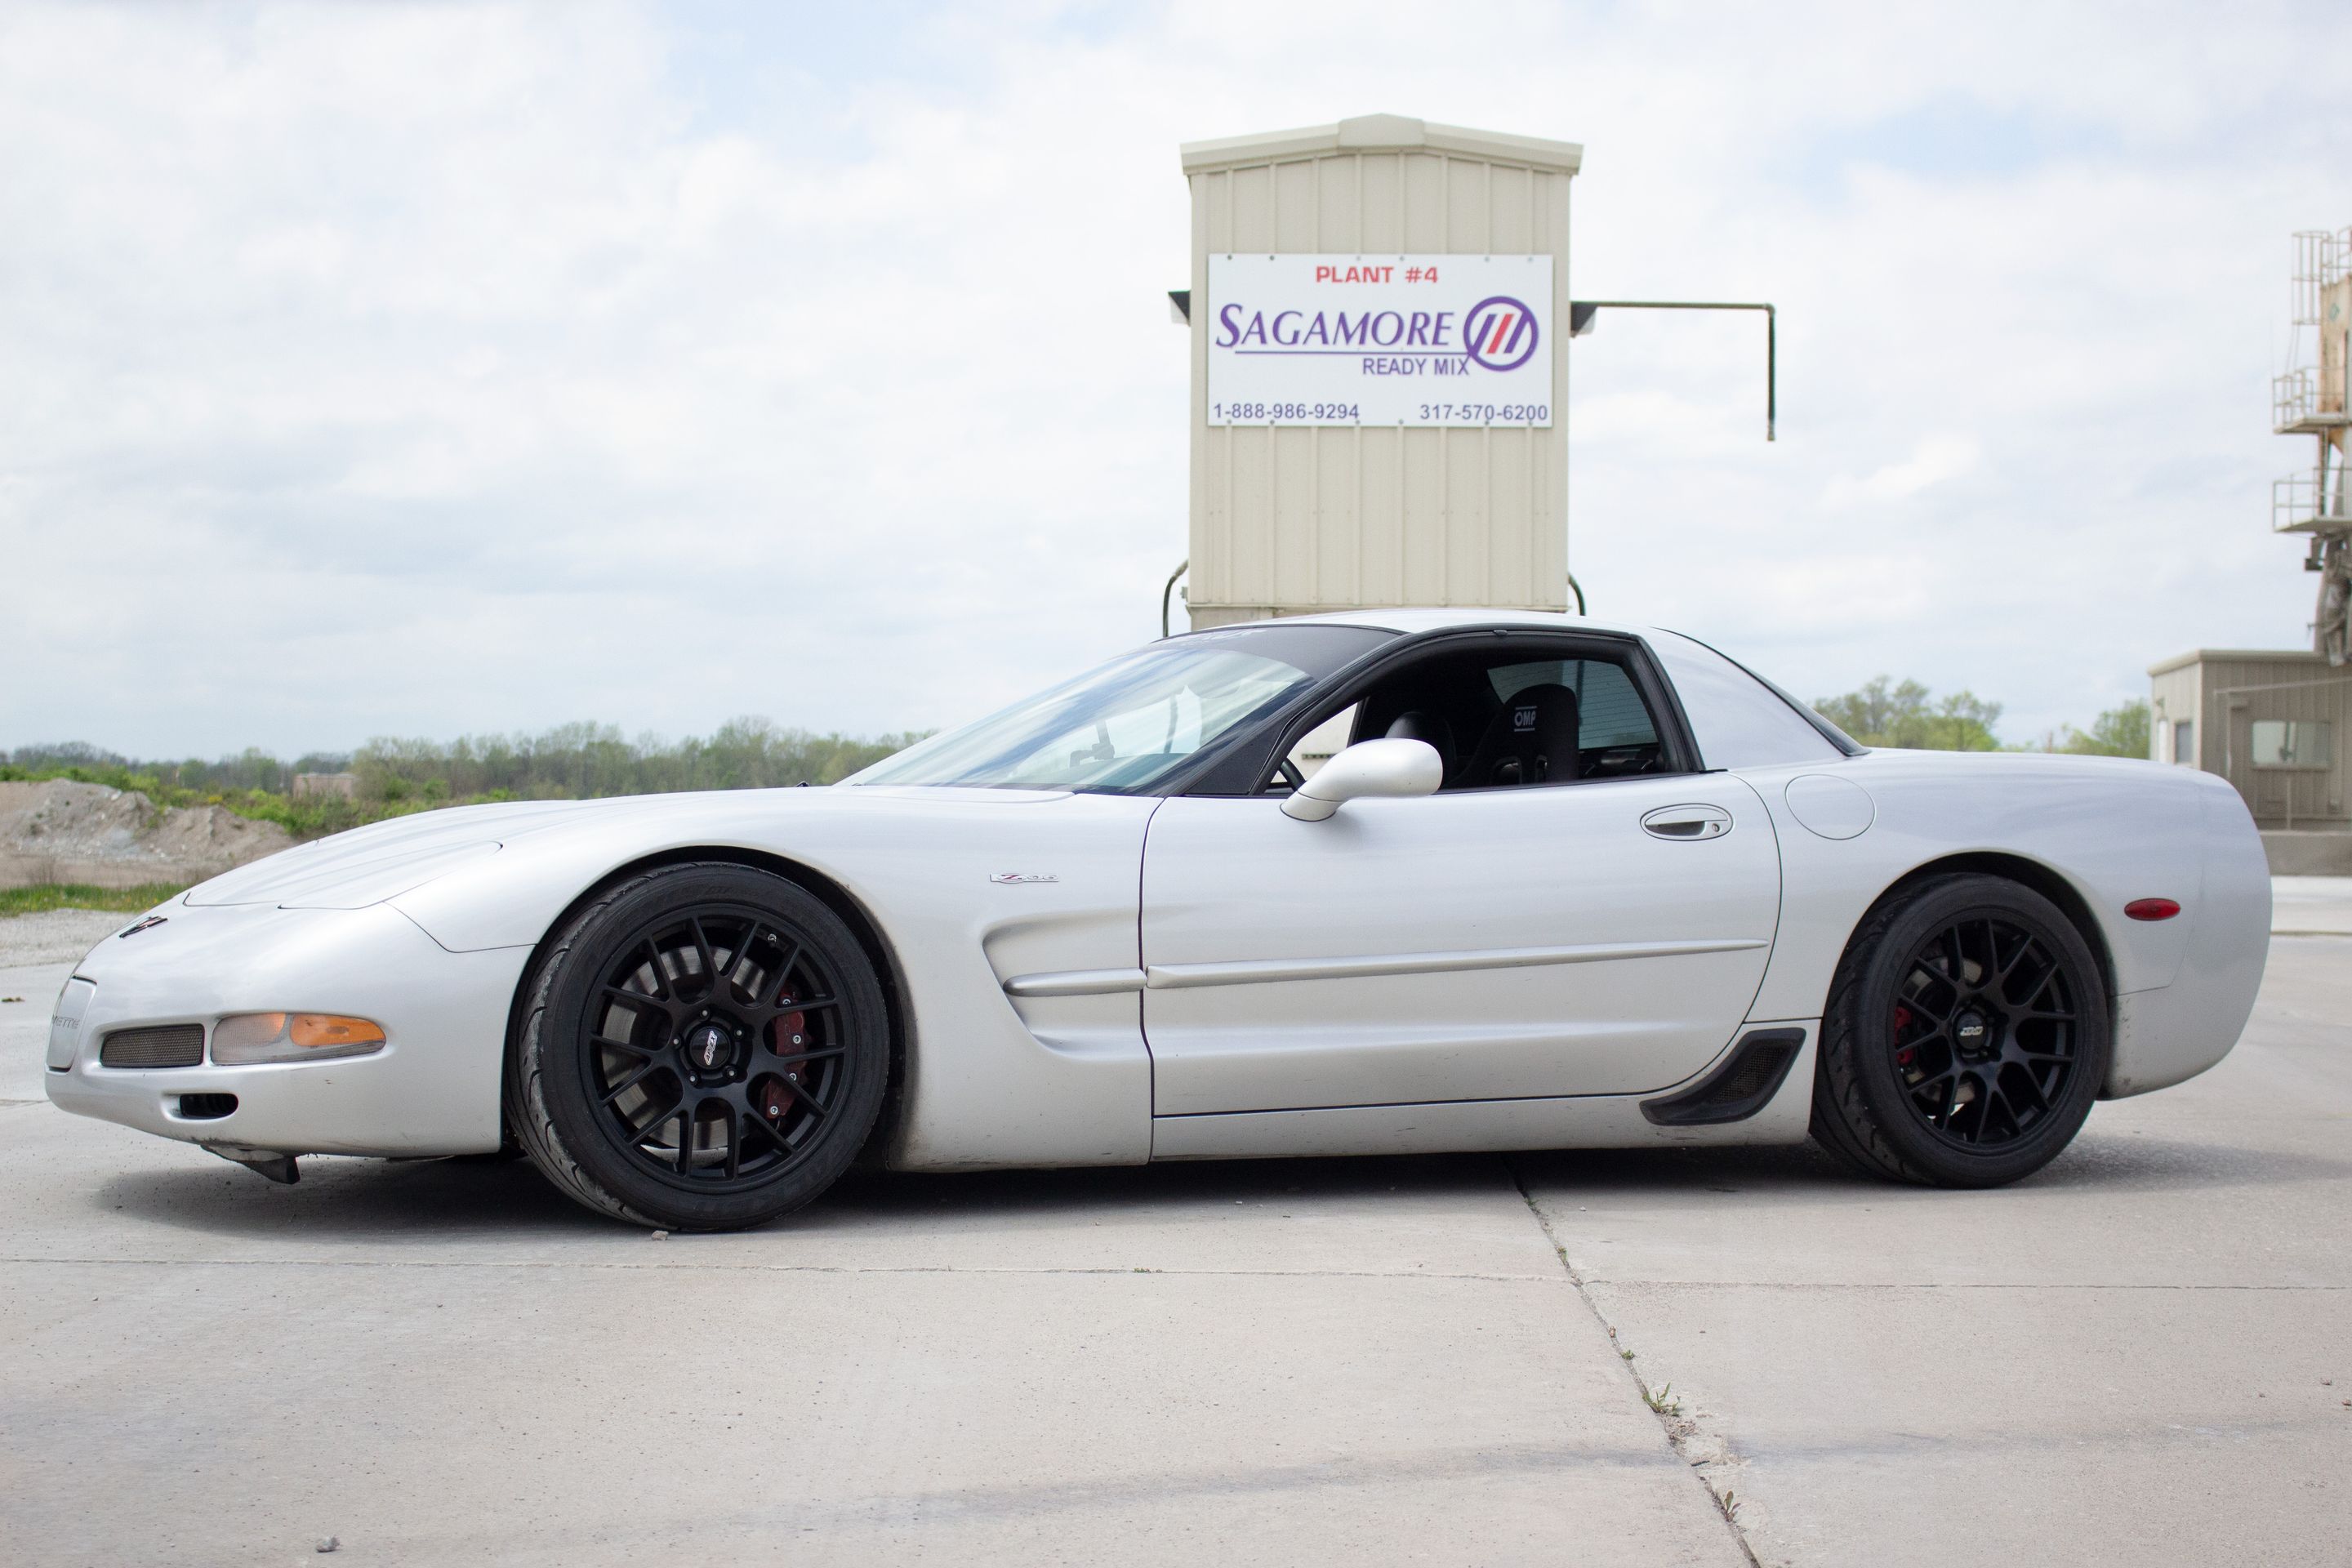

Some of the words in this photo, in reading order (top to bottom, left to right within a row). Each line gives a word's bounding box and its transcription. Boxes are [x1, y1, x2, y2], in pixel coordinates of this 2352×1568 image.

[1316, 266, 1394, 283] PLANT
[1405, 267, 1438, 283] #4
[1215, 303, 1454, 349] SAGAMORE
[1363, 358, 1427, 375] READY
[1434, 358, 1469, 376] MIX
[1214, 403, 1360, 420] 1-888-986-9294
[1420, 404, 1548, 421] 317-570-6200
[1514, 710, 1536, 727] OMP
